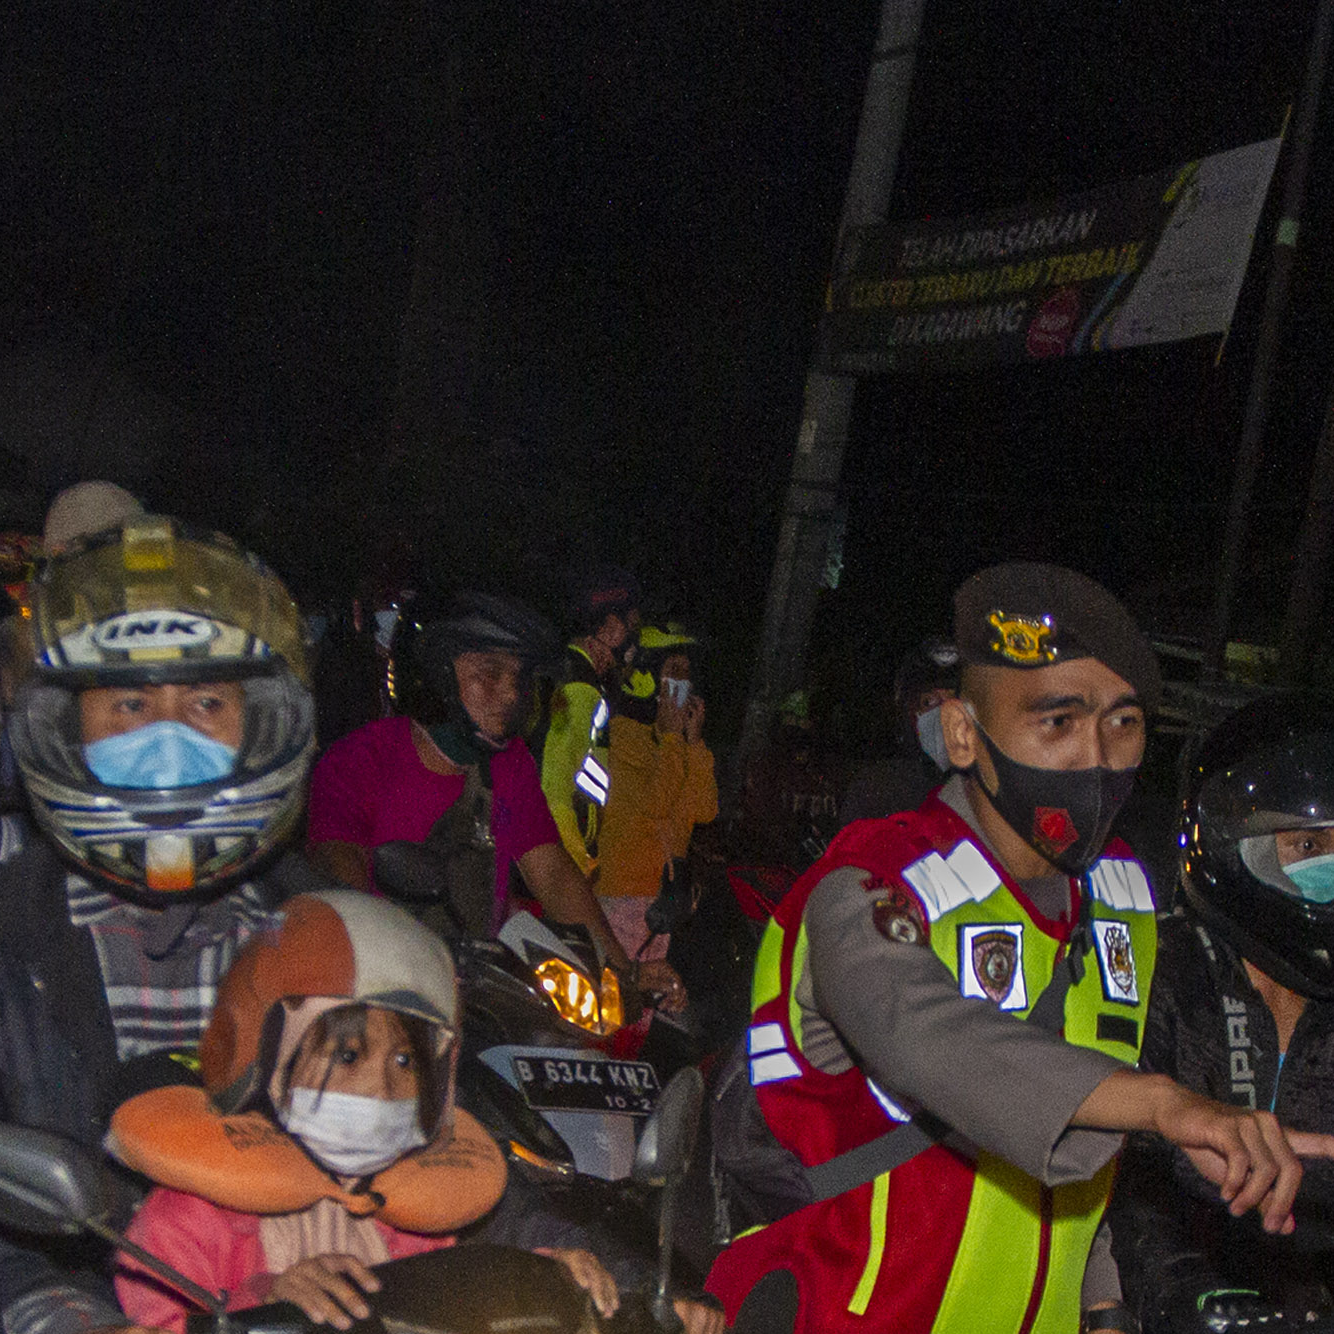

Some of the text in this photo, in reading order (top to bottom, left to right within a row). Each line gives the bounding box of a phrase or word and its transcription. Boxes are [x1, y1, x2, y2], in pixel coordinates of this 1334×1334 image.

[105, 620, 200, 640] INK
[517, 1060, 654, 1089] B 6344 KNZ
